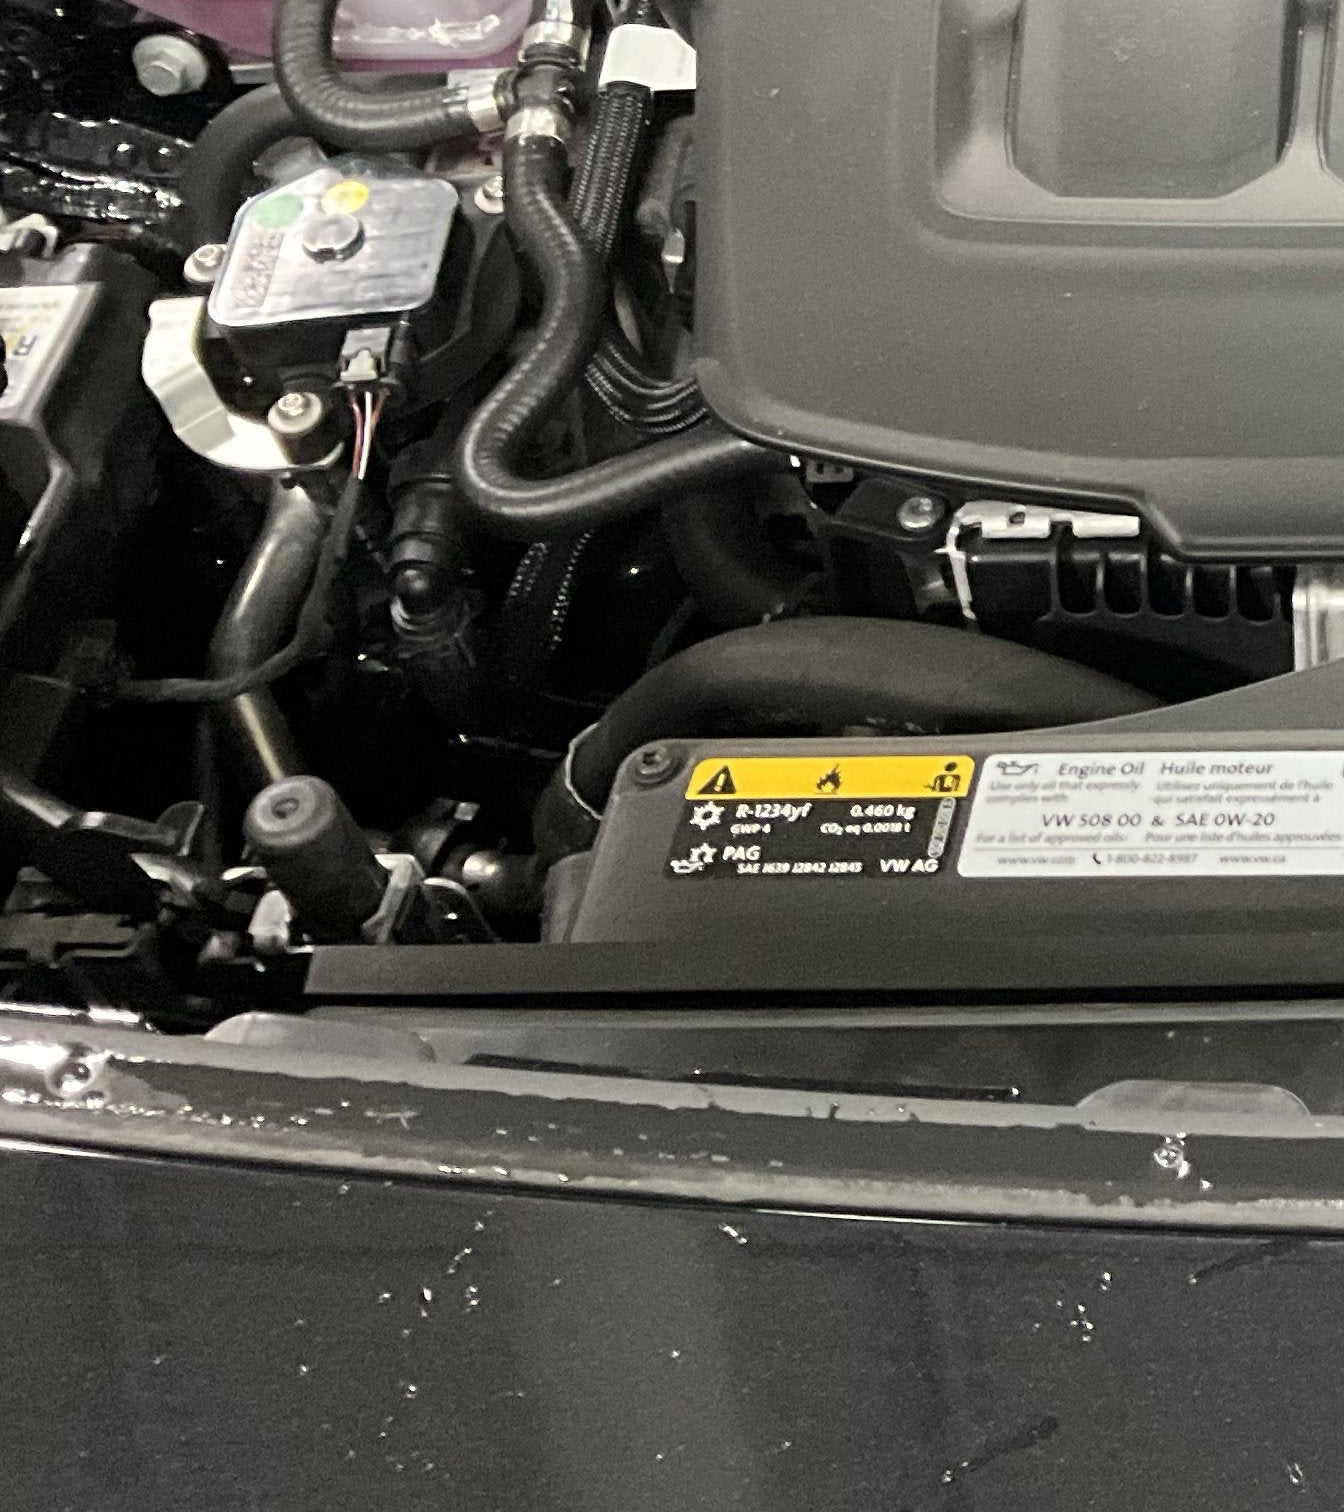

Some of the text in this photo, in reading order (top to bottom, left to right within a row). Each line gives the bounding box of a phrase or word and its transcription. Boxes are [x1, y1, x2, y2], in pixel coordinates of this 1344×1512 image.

[1058, 762, 1144, 779] Engine Oil
[1160, 762, 1273, 774] Huile moteur
[1059, 780, 1083, 790] that
[1204, 780, 1276, 793] uniquement
[1279, 780, 1295, 790] de
[735, 802, 812, 822] R-1234yf
[850, 803, 915, 820] 0.460 kg
[1042, 813, 1275, 827] VW 508 00 & SAE 0W-20
[730, 824, 761, 835] GWP
[722, 845, 761, 860] PAG
[737, 862, 761, 873] SAE
[880, 859, 939, 872] VW AG
